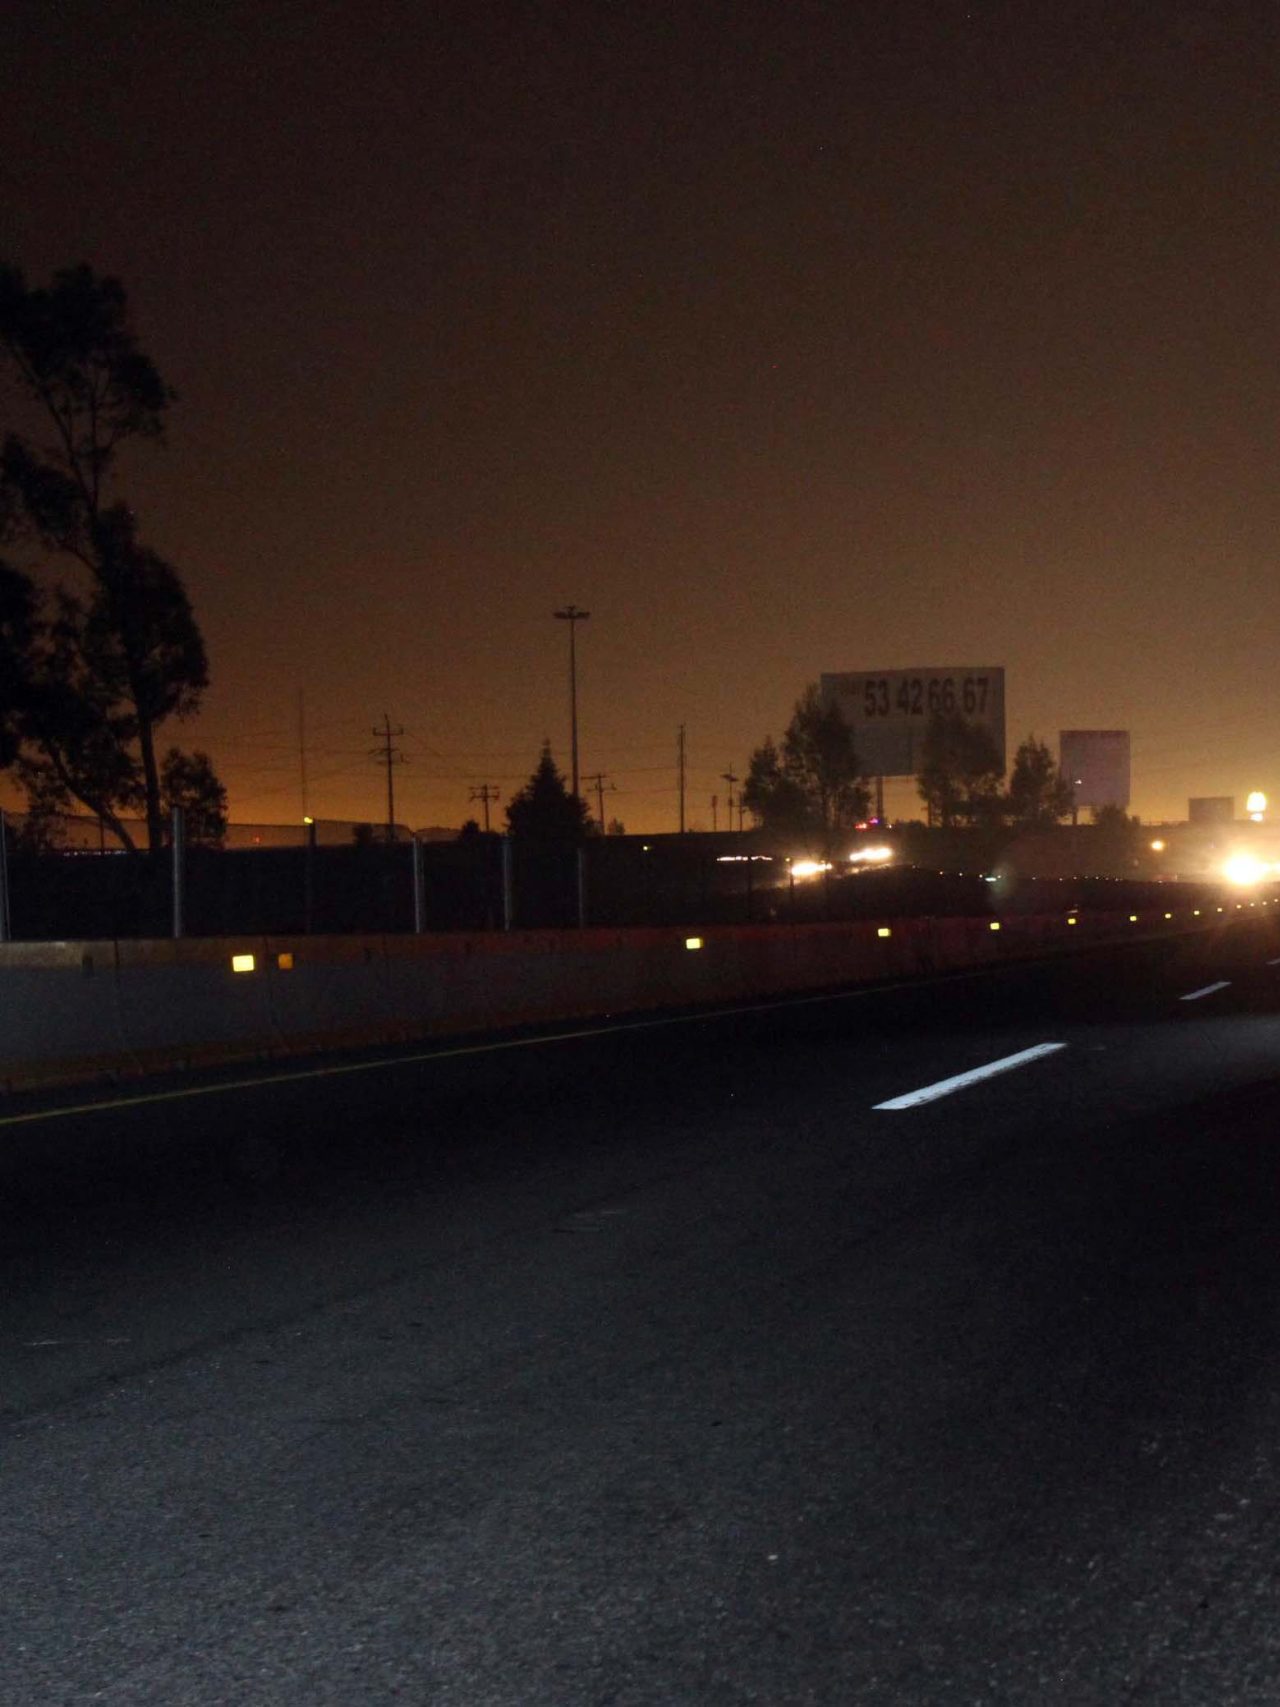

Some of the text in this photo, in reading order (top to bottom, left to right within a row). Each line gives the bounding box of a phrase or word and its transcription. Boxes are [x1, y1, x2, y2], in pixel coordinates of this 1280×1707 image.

[864, 678, 890, 718] 53
[896, 677, 924, 716] 42
[928, 676, 955, 714] 66
[963, 676, 990, 714] 67
